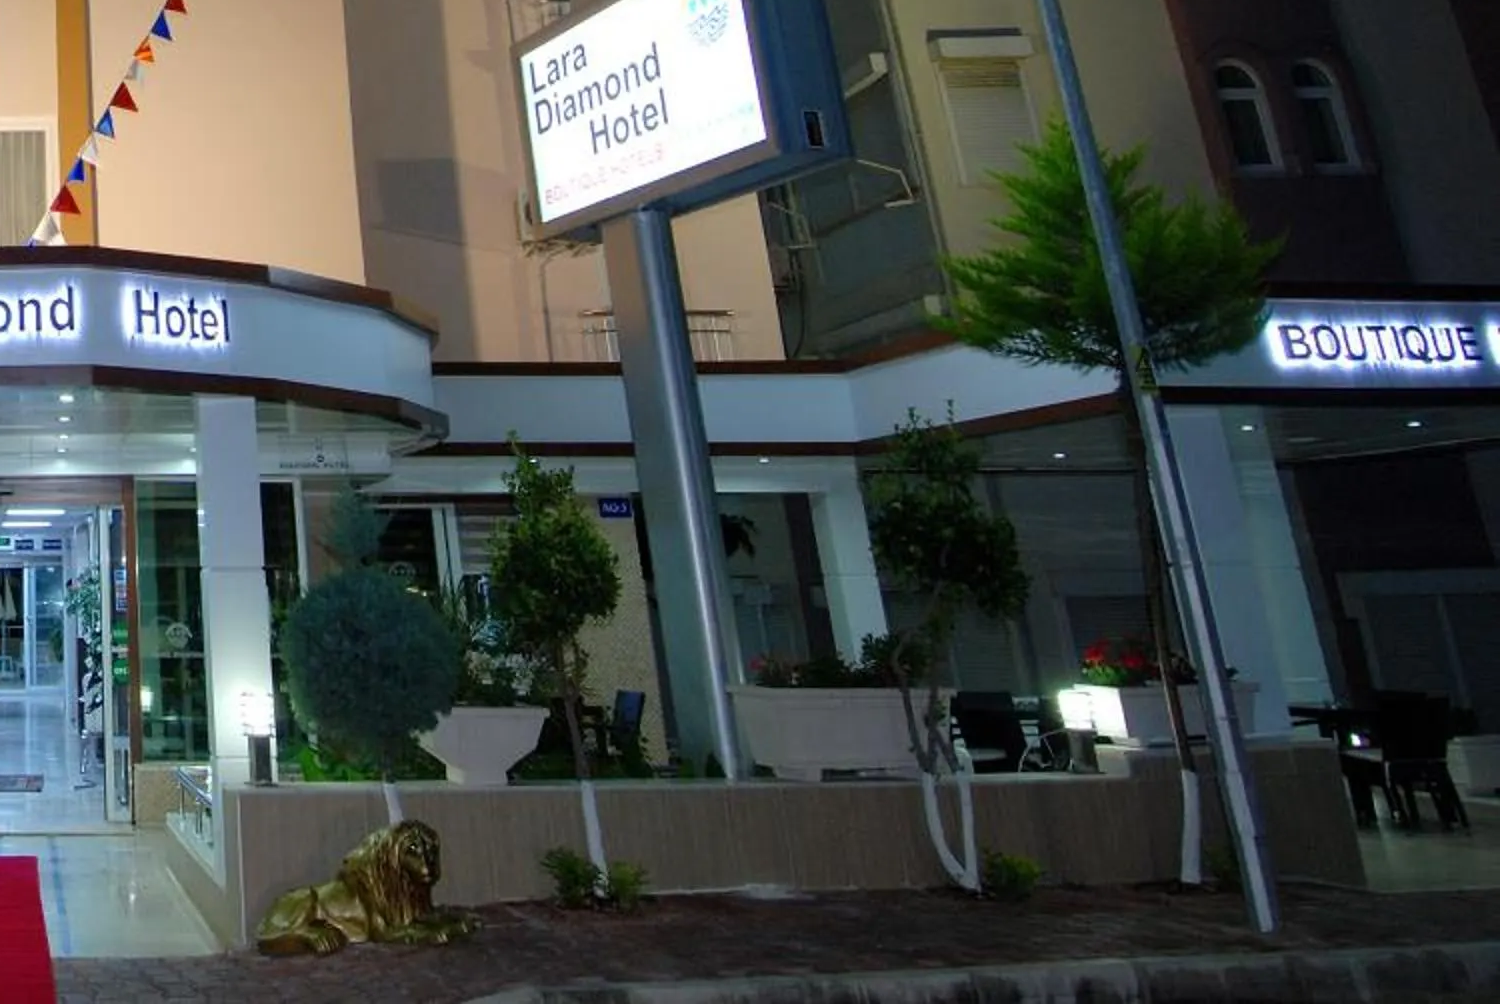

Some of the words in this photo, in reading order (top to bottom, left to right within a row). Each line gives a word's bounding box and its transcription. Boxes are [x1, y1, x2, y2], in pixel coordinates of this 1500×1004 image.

[529, 43, 588, 94] Lara
[534, 42, 662, 134] Diamond
[589, 88, 669, 154] Hotel
[132, 289, 231, 344] Hotel
[1277, 324, 1484, 364] BOUTIQUE
